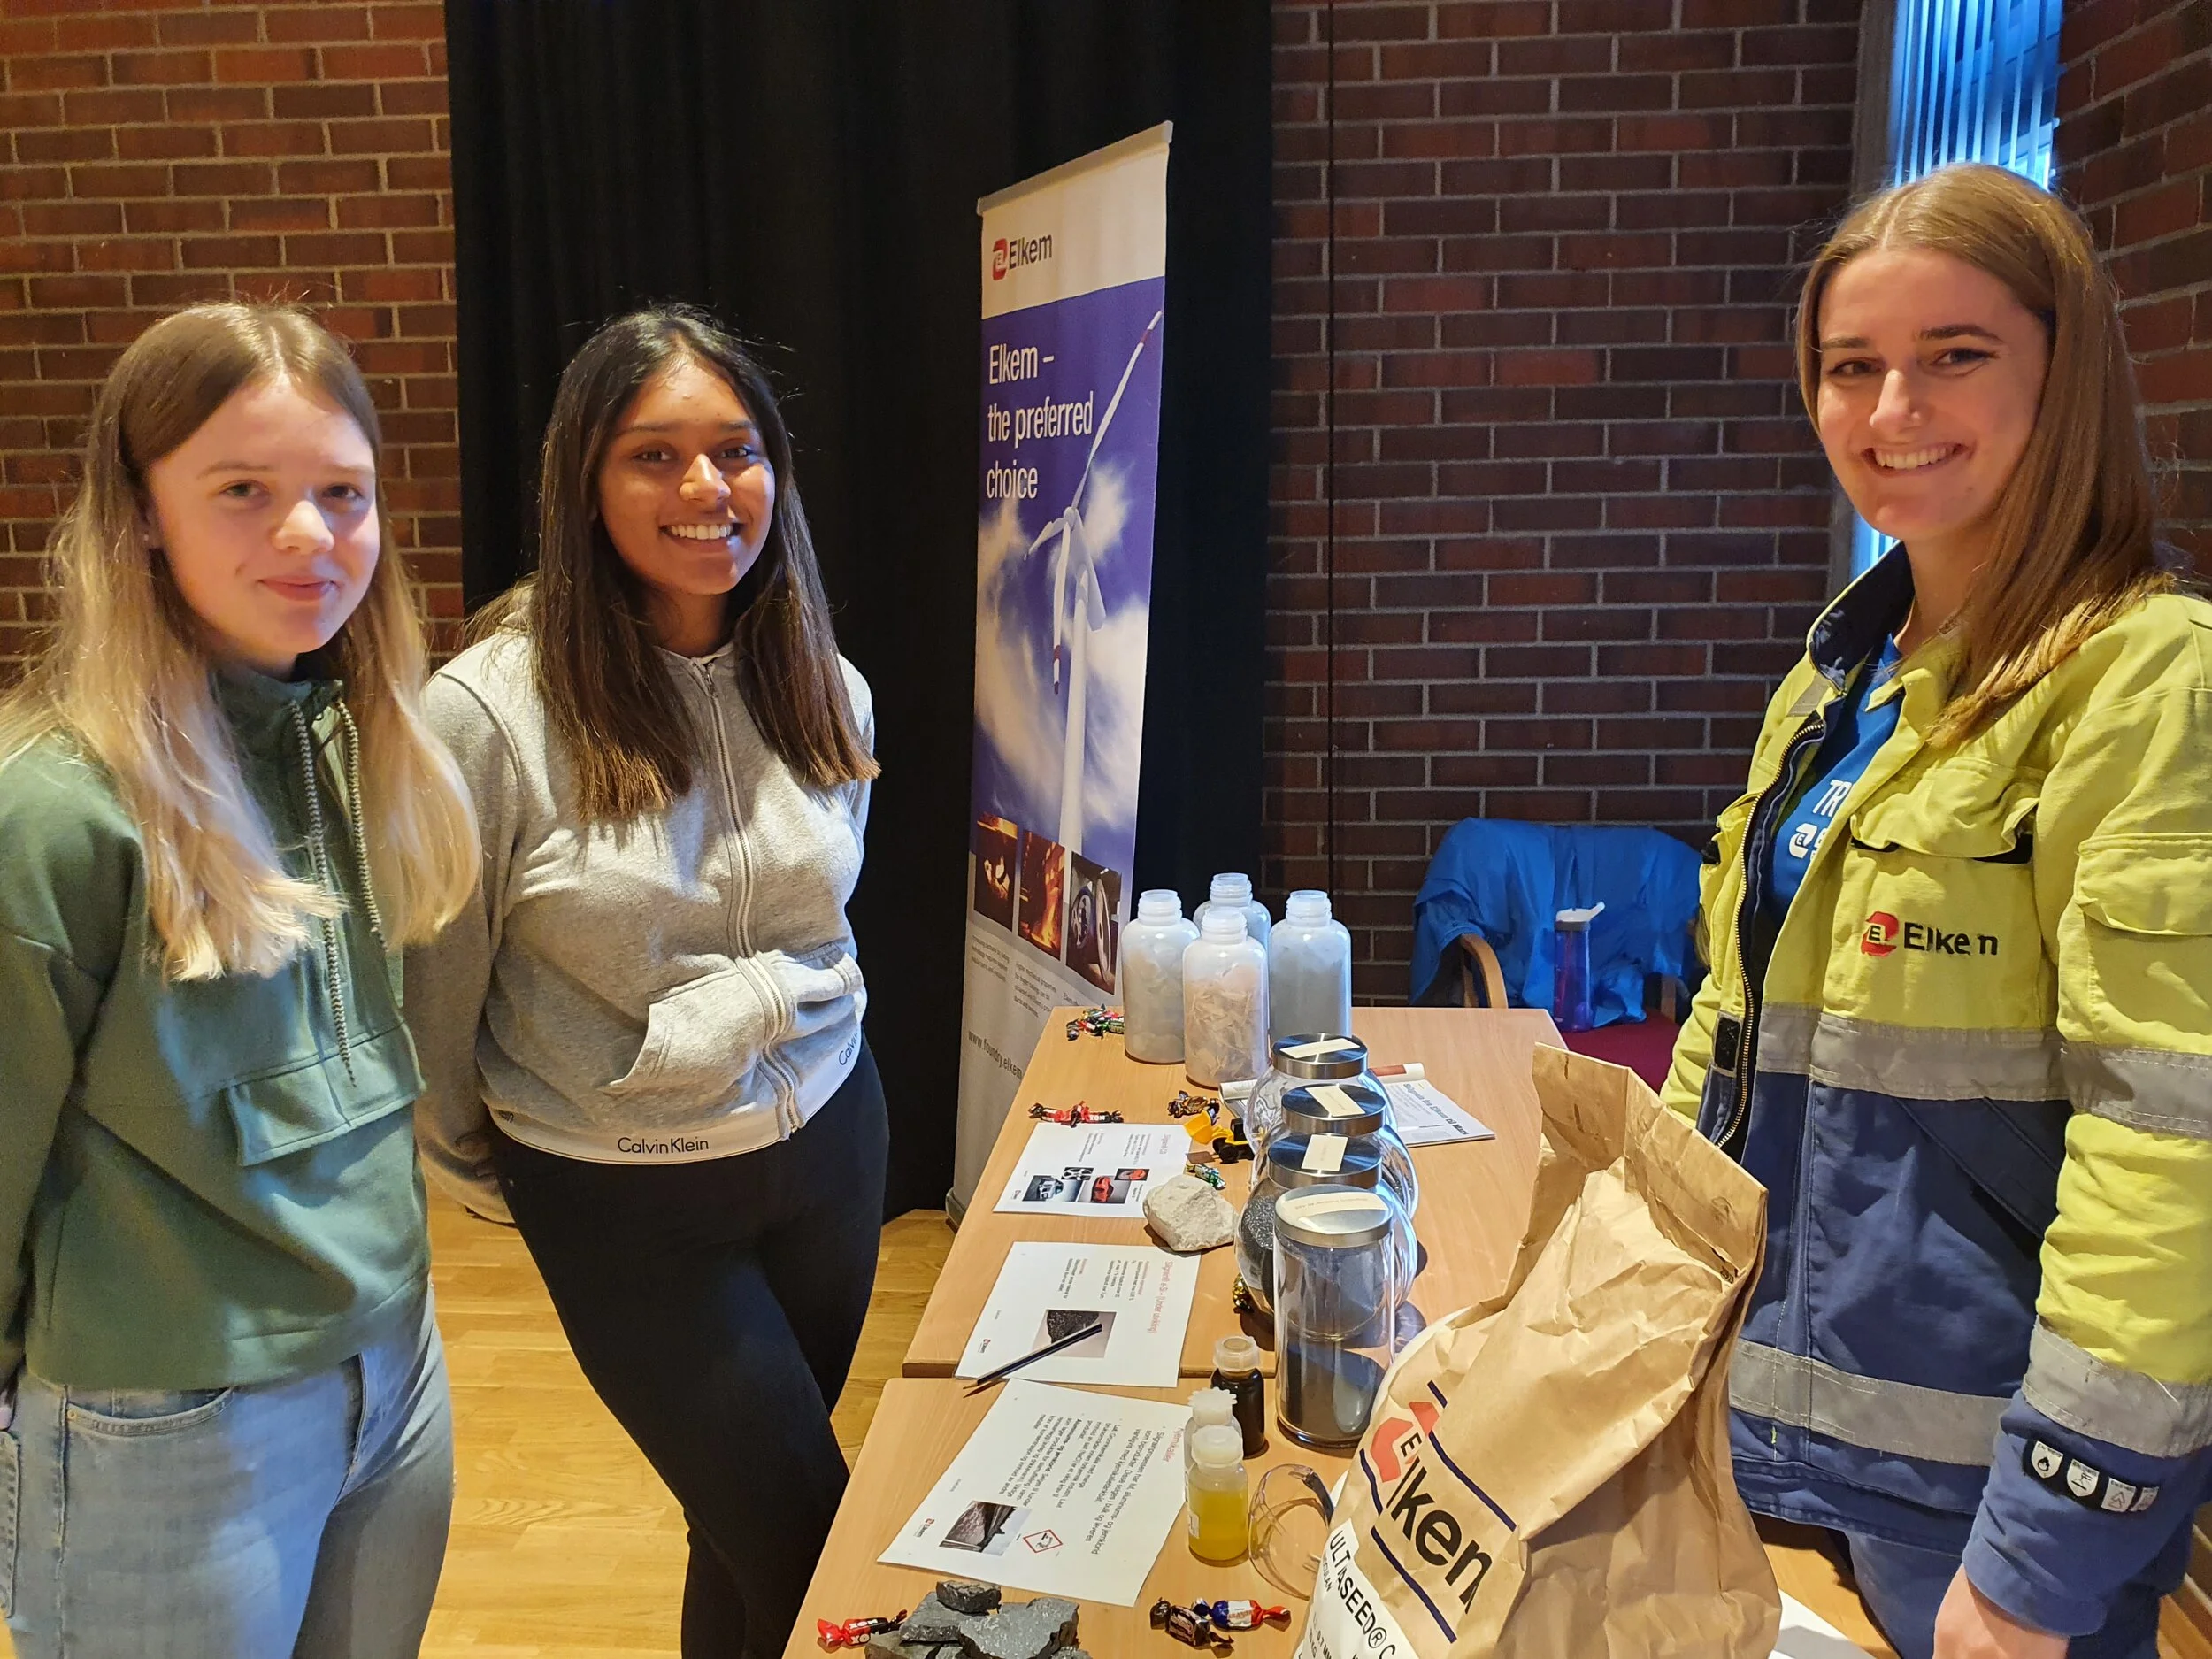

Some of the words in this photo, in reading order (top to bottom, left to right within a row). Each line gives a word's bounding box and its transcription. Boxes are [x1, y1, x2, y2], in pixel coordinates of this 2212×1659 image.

[1009, 234, 1052, 270] Elkem
[989, 343, 1038, 385] Elkem
[987, 403, 1010, 442] the
[1015, 390, 1094, 449] preferred
[987, 459, 1038, 499] choice
[618, 1137, 669, 1154] Calvin
[670, 1136, 709, 1153] Klein
[1330, 1531, 1387, 1648] ULTASEED®
